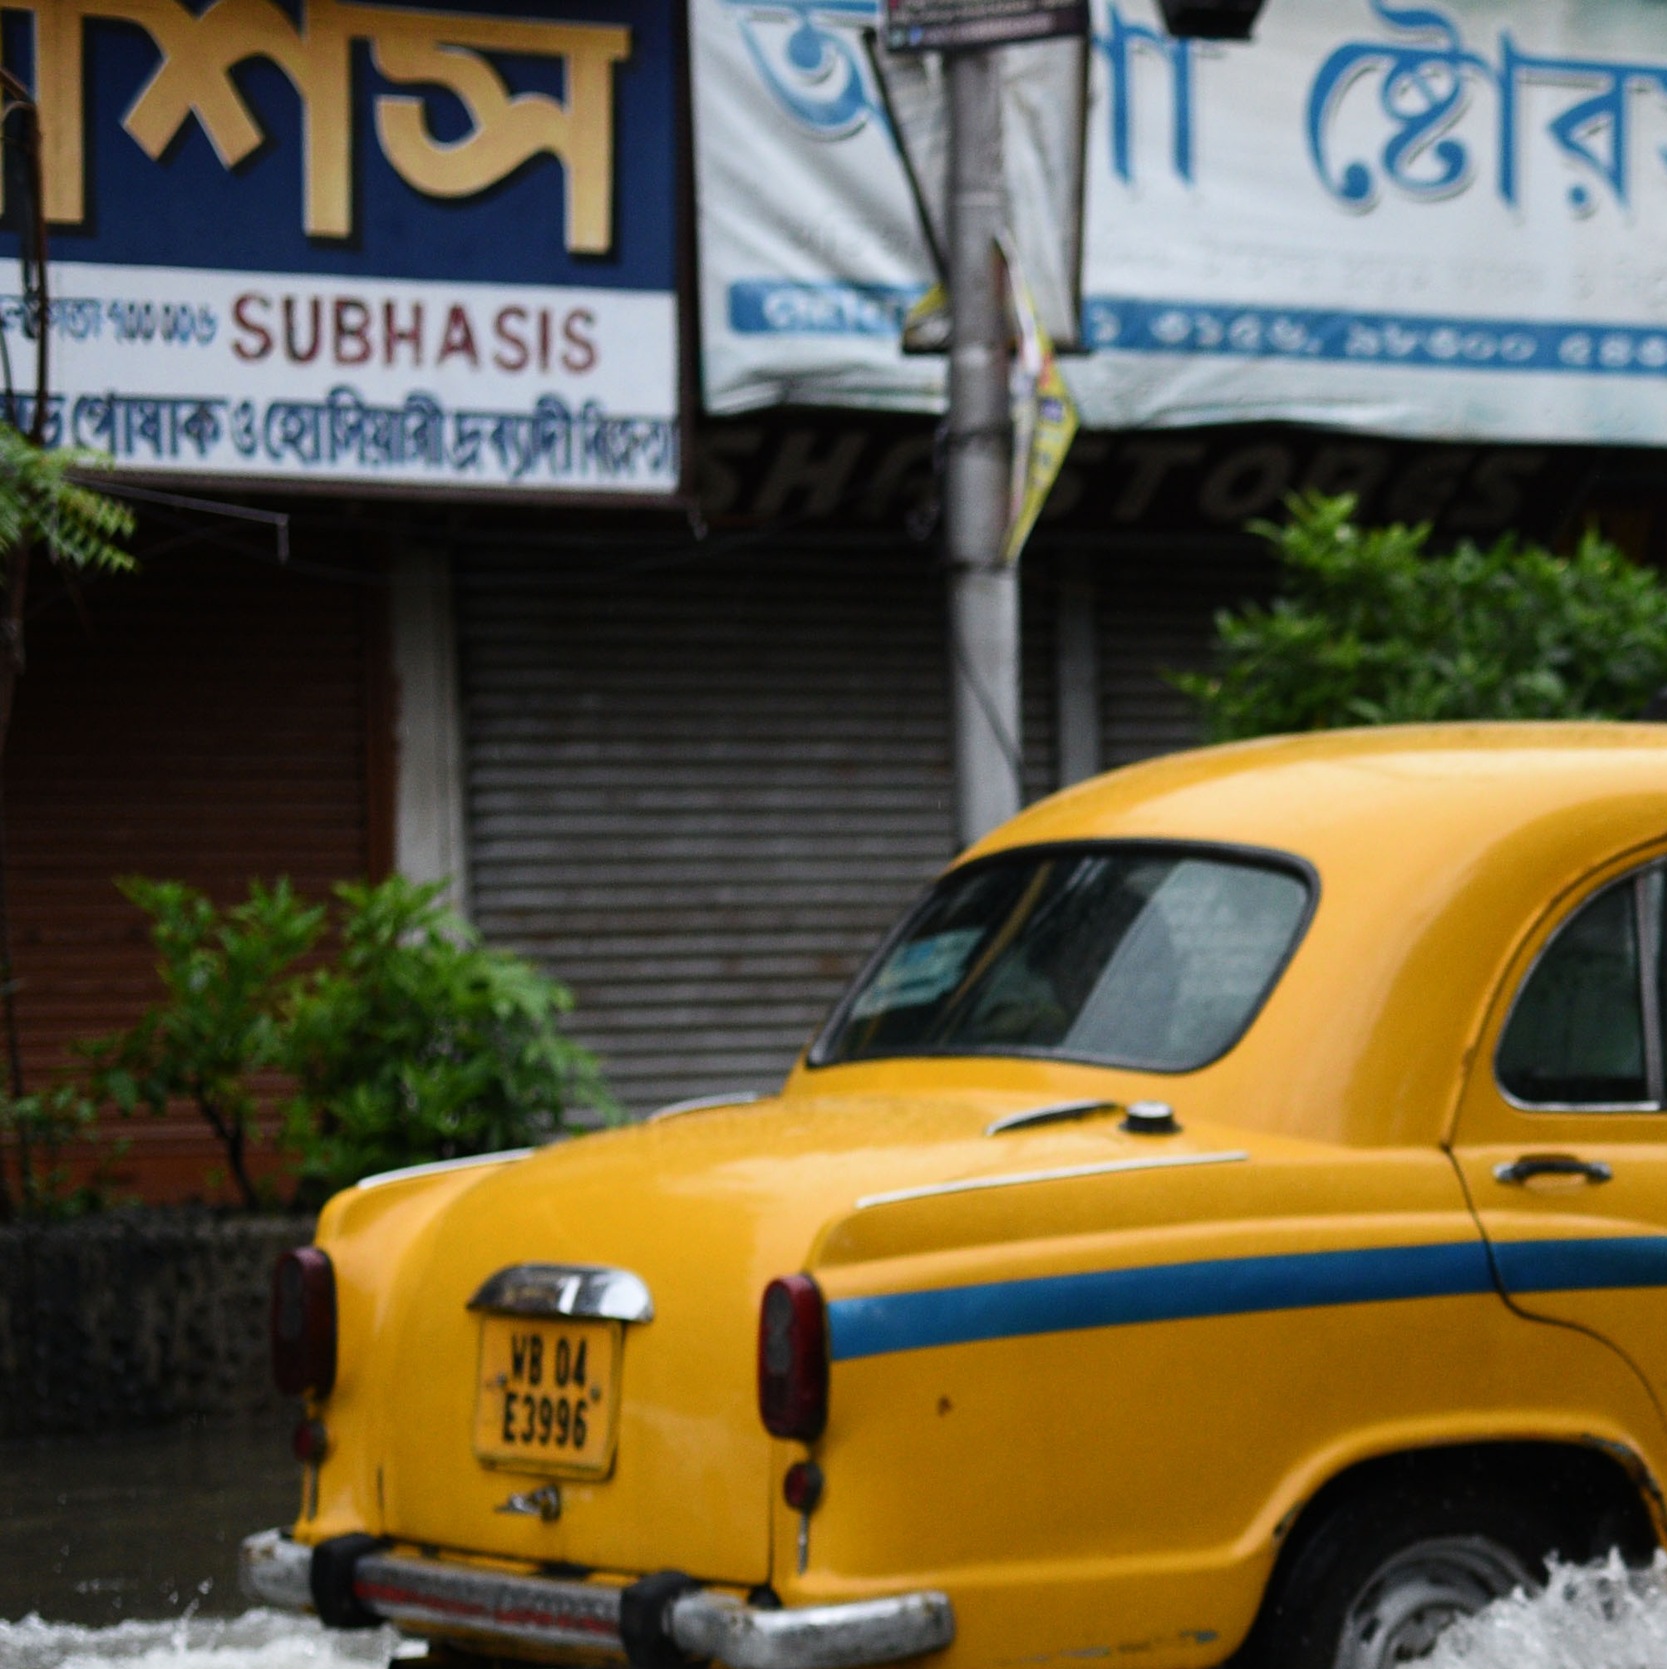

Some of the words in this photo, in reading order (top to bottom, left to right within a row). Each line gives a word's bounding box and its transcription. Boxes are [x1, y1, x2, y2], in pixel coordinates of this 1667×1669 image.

[232, 290, 600, 376] SUBHASIS
[511, 1333, 544, 1387] WB
[555, 1336, 588, 1388] 04
[502, 1391, 588, 1450] E3996
